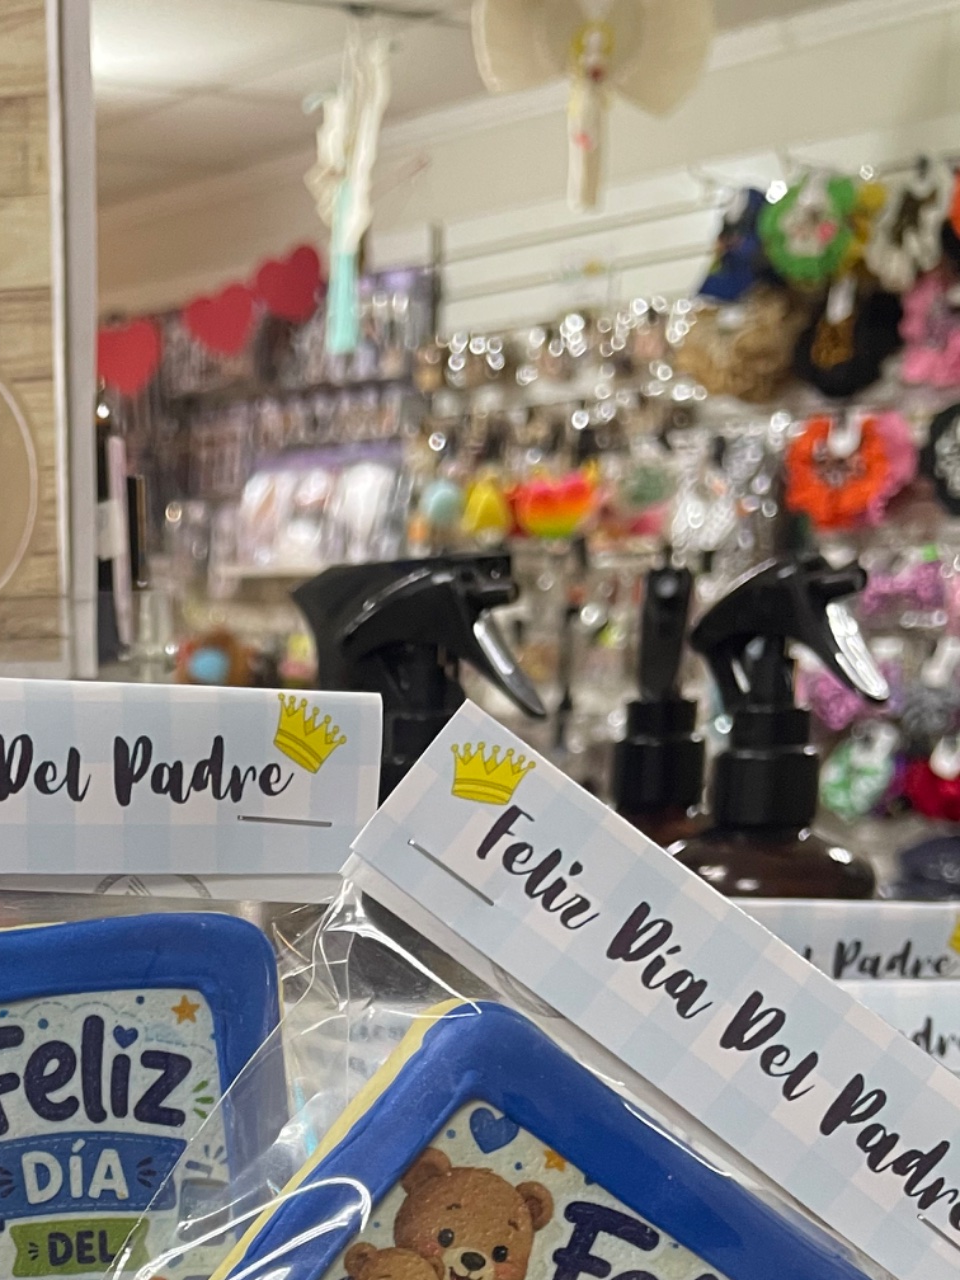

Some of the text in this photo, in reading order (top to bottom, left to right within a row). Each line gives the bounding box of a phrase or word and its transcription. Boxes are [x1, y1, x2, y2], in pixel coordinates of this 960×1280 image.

[112, 735, 295, 807] Padre
[474, 803, 603, 930] Feliz
[605, 900, 714, 1020] Día
[719, 988, 821, 1102] Del
[832, 938, 955, 979] Padre
[19, 1138, 131, 1206] DÍA
[47, 1229, 121, 1267] DEL
